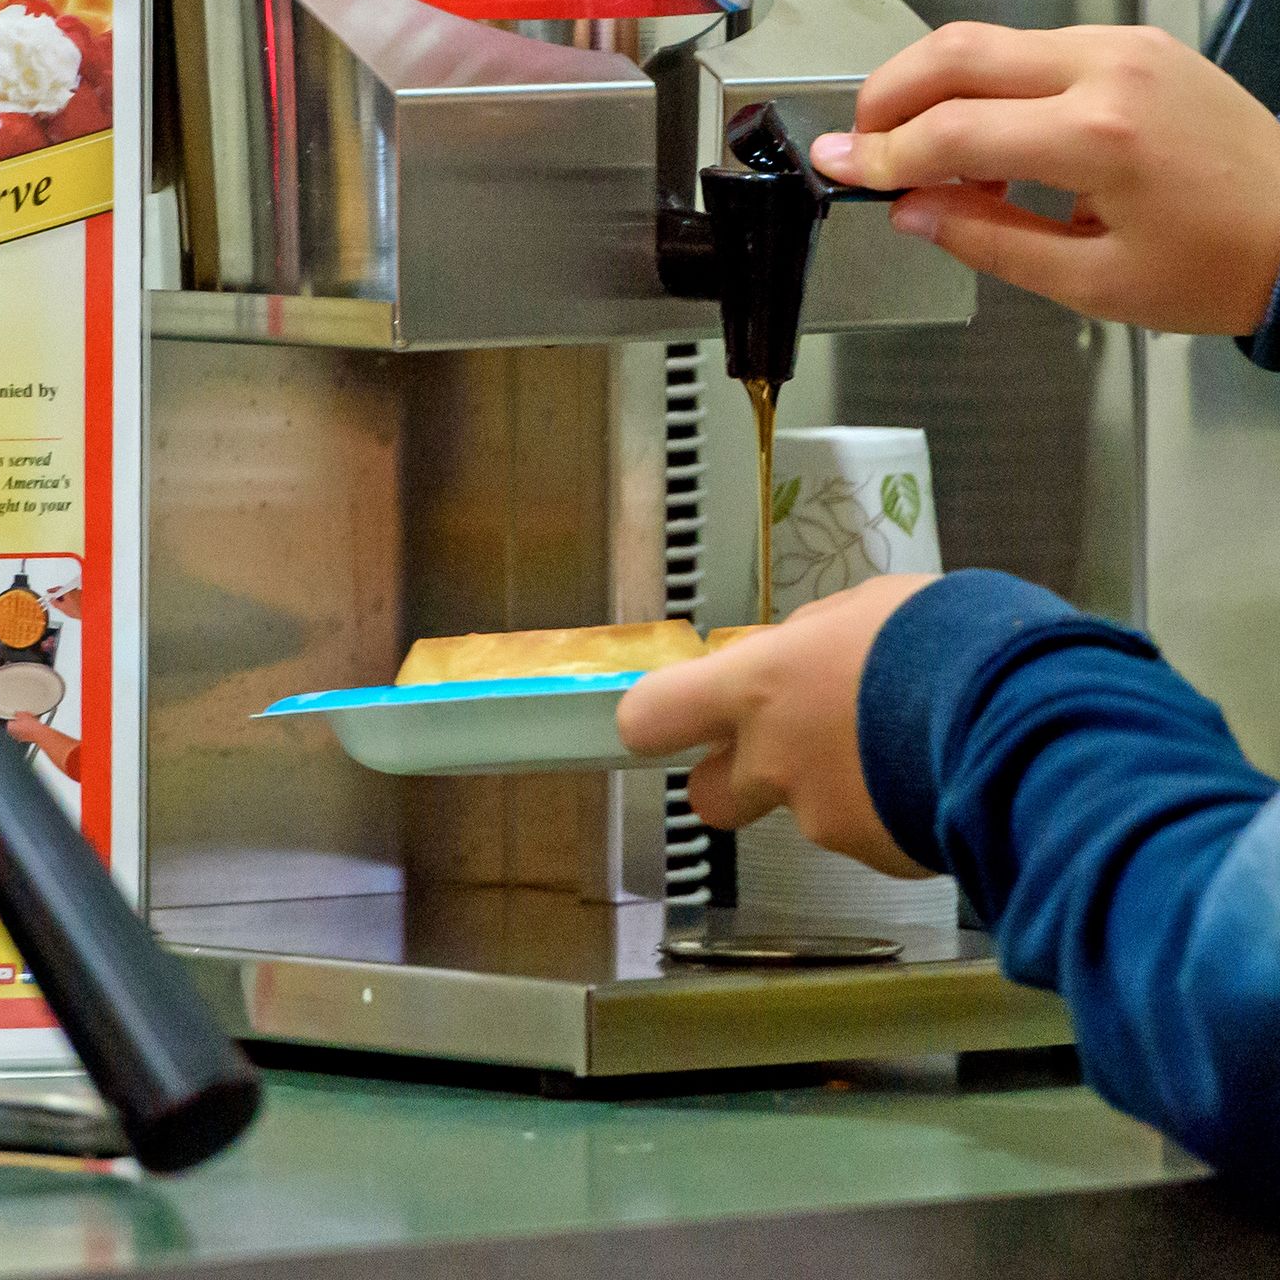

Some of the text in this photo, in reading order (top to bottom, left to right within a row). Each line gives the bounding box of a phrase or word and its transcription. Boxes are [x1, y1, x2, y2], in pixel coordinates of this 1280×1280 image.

[38, 383, 59, 402] by
[9, 452, 52, 467] served
[3, 474, 71, 490] America's
[23, 500, 36, 513] to
[38, 501, 73, 517] your
